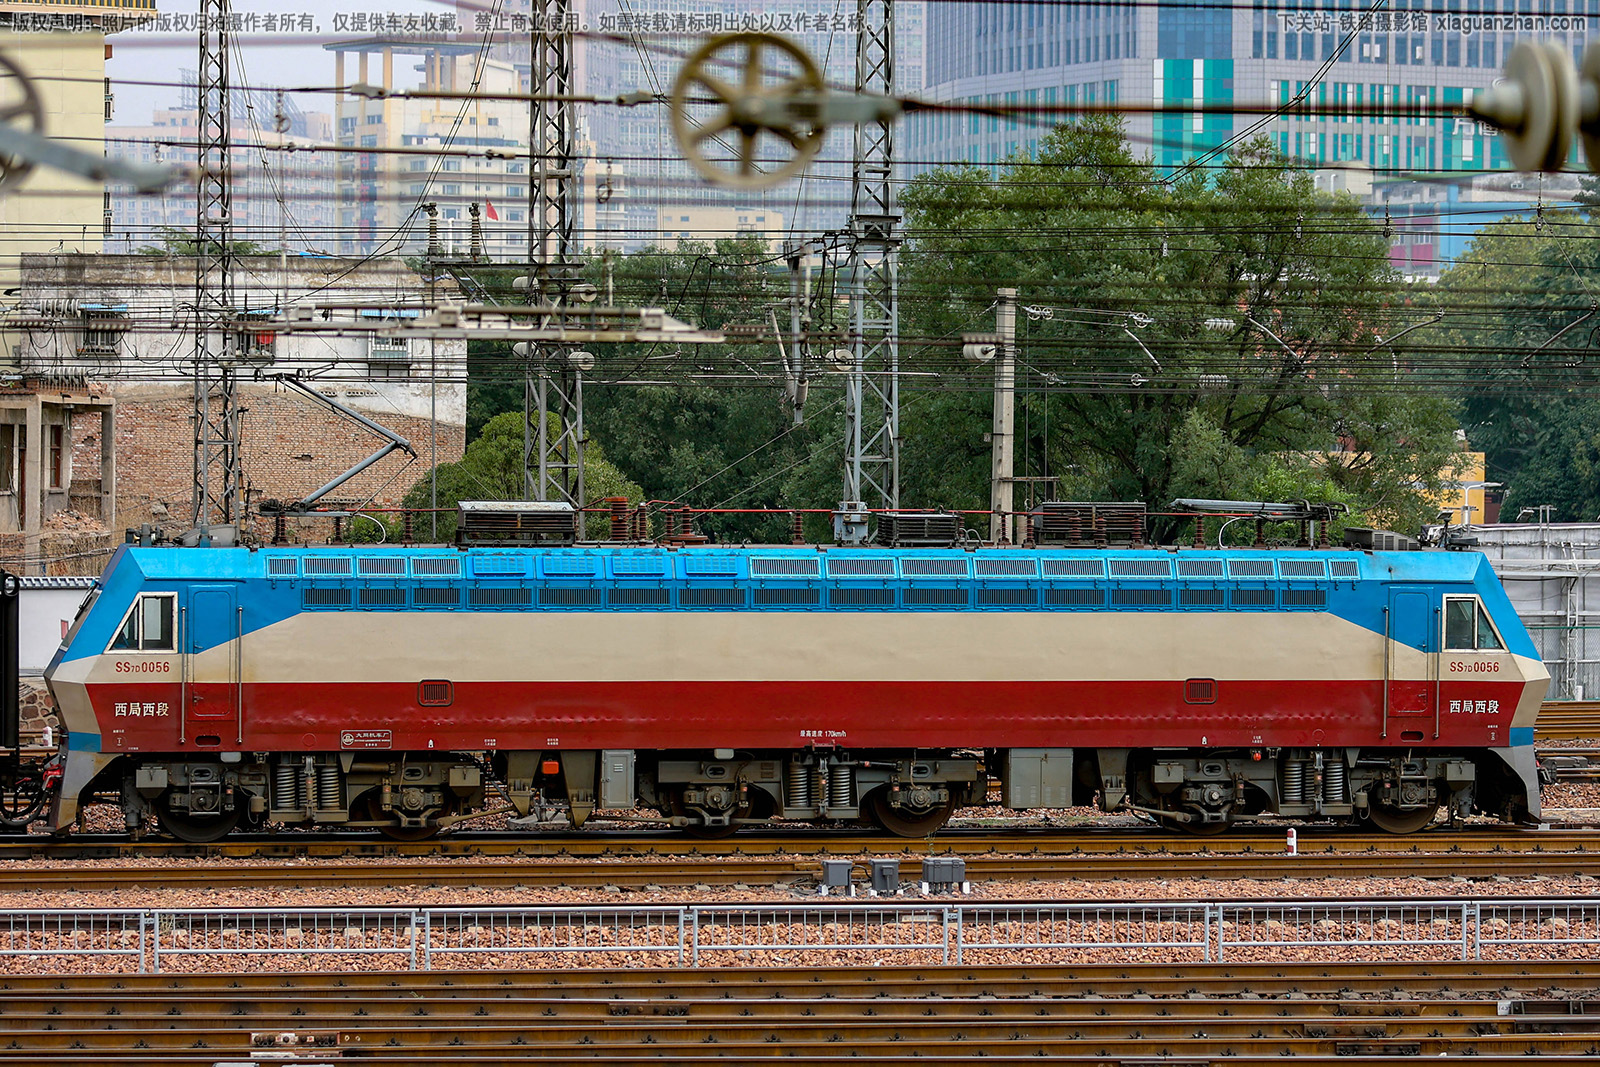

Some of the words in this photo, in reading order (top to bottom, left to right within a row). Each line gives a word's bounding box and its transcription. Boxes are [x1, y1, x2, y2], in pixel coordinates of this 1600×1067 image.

[115, 661, 170, 673] SS7D0056
[1449, 661, 1500, 673] SS7D0056
[114, 702, 169, 717] 西局西段
[1449, 700, 1500, 714] 西局西段
